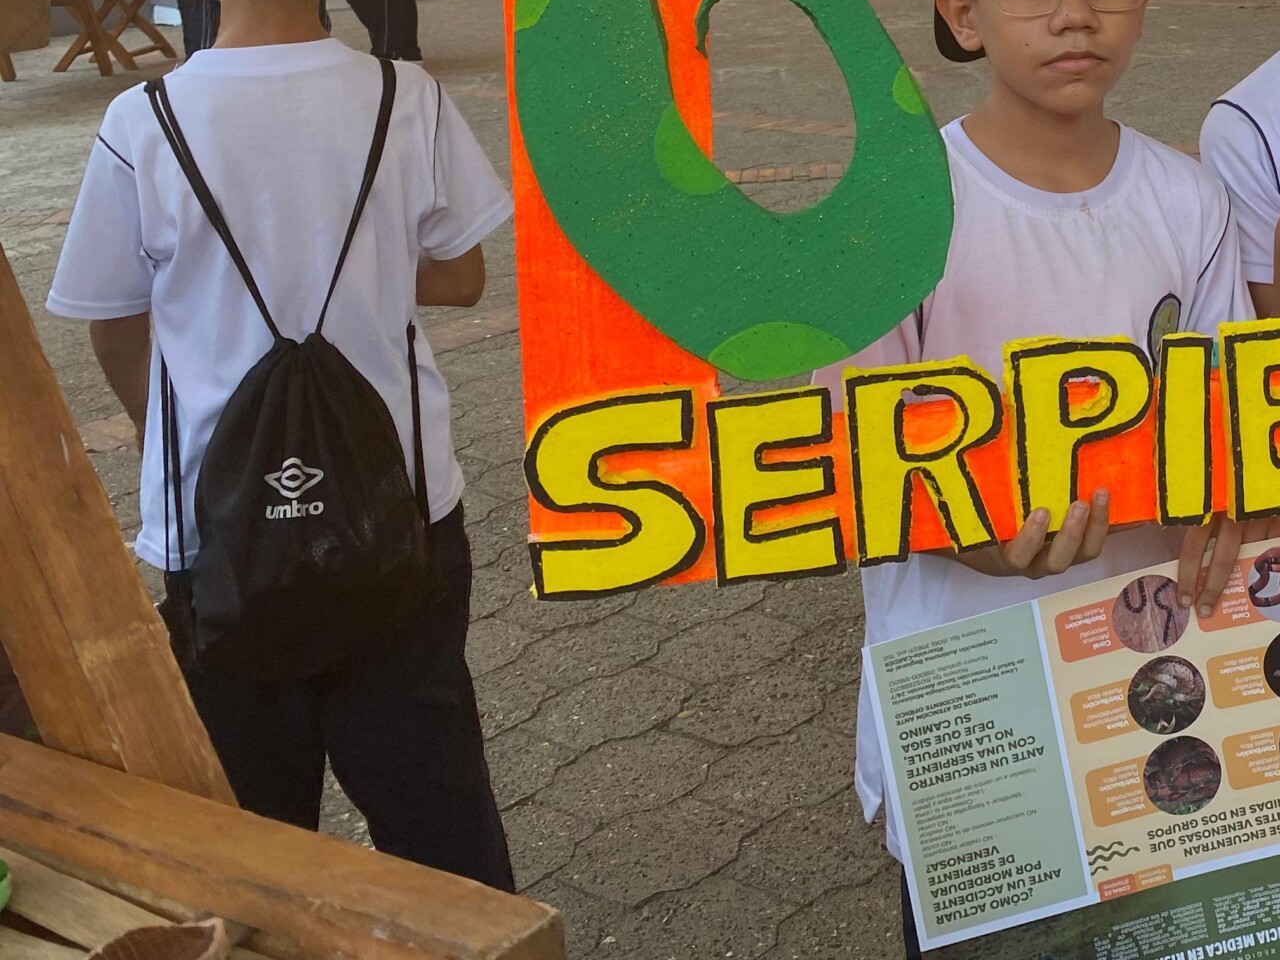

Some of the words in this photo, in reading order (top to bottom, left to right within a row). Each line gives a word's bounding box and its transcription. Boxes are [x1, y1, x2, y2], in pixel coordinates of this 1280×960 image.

[265, 500, 324, 519] umbro
[925, 695, 963, 710] ACCIDENTE
[894, 706, 924, 720] OFÍDICO
[895, 716, 914, 725] ANTE
[916, 706, 951, 721] ATENCIÓN
[954, 713, 971, 725] SU
[898, 718, 951, 741] CAMINO
[963, 720, 994, 736] DEJE
[993, 727, 1013, 740] NO
[933, 729, 961, 744] QUE
[975, 733, 991, 746] LA
[1008, 735, 1035, 750] CON
[900, 737, 931, 753] SIGA
[903, 738, 972, 766] MANIPULE,
[976, 743, 1005, 759] UNA
[1011, 745, 1045, 762] ANTE
[906, 752, 974, 778] SERPIENTE
[989, 755, 1008, 768] UN
[908, 761, 987, 791] ENCUENTRO
[1026, 808, 1036, 816] NO
[1200, 811, 1227, 826] DOS
[1229, 806, 1247, 819] EN
[937, 819, 948, 827] NO
[1146, 818, 1199, 839] GRUPOS
[982, 834, 992, 842] NO
[1178, 818, 1252, 845] VENENOSAS
[1148, 837, 1176, 852] QUE
[1182, 828, 1266, 856] ENCUENTRAN
[925, 845, 999, 873] VENENOSA?
[997, 853, 1015, 866] DE
[927, 859, 995, 885] SERPIENTE
[1014, 860, 1041, 875] POR
[930, 868, 1012, 898] MORDEDURA
[1028, 867, 1062, 885] ANTE
[1006, 878, 1025, 891] UN
[932, 884, 1004, 911] ACCIDENTE
[988, 887, 1034, 911] ¿CÓMO
[935, 902, 987, 924] ACTUAR
[1186, 945, 1204, 960] EN
[1204, 933, 1256, 960] MÉDICA
